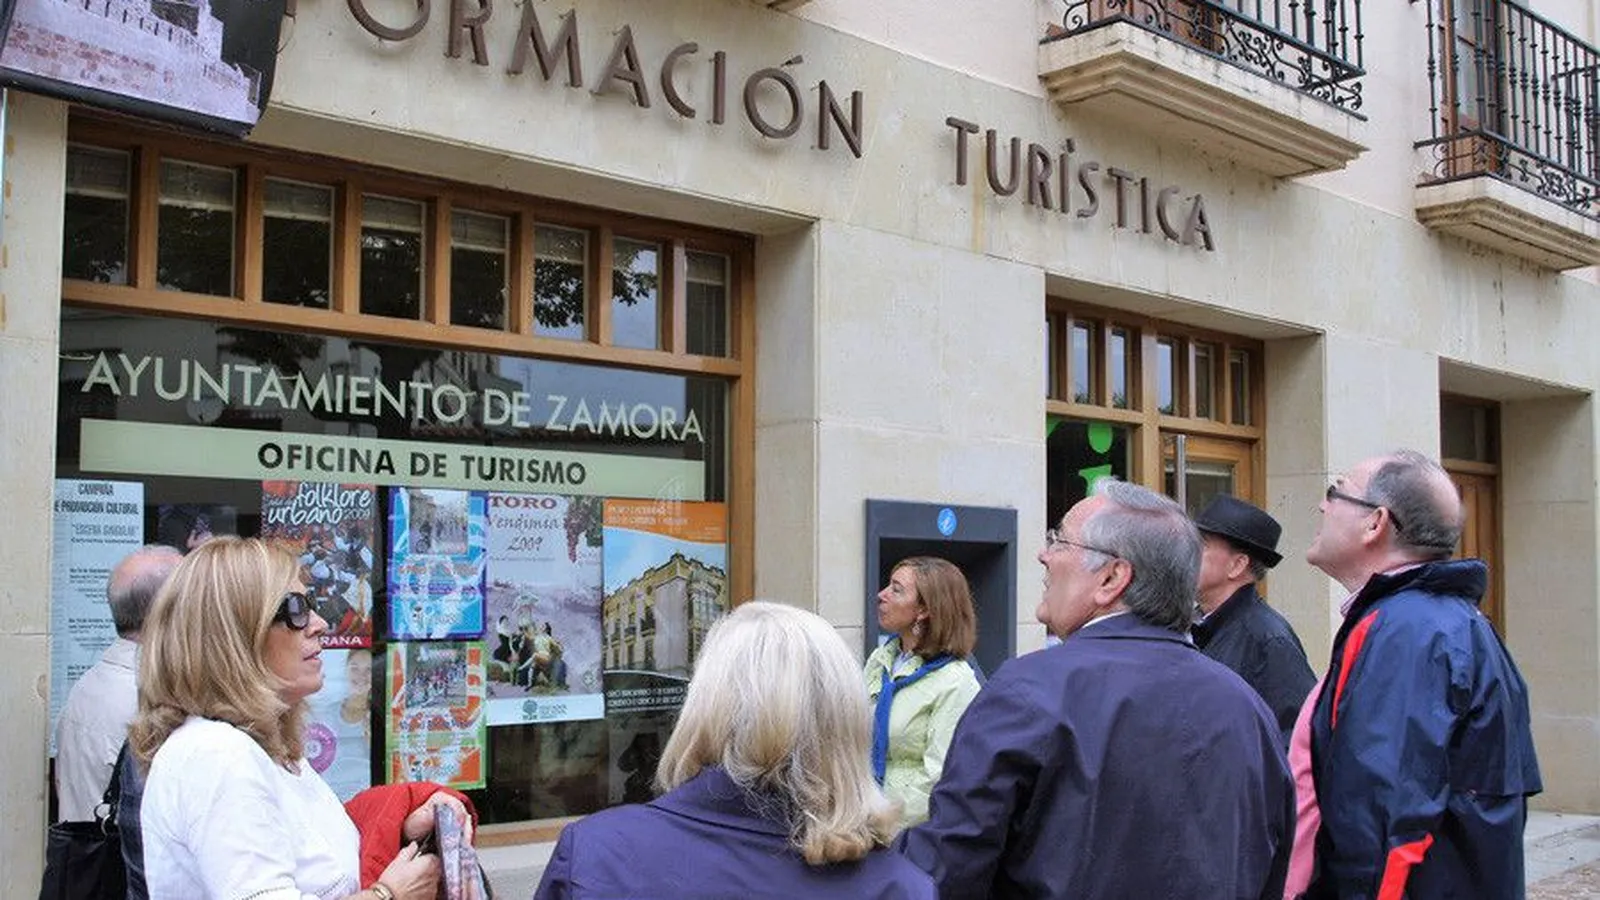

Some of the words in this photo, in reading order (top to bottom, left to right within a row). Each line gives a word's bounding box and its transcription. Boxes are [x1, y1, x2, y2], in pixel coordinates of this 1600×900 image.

[945, 116, 1215, 251] TURÍSTICA
[81, 350, 468, 423] AYUNTAMIENTO
[483, 387, 531, 428] DE
[545, 394, 705, 442] ZAMORA
[257, 442, 396, 475] OFICINA
[410, 451, 447, 478] DE
[460, 455, 587, 485] TURISMO
[267, 499, 343, 525] urbano
[296, 482, 372, 508] folklore
[489, 495, 557, 509] TORO
